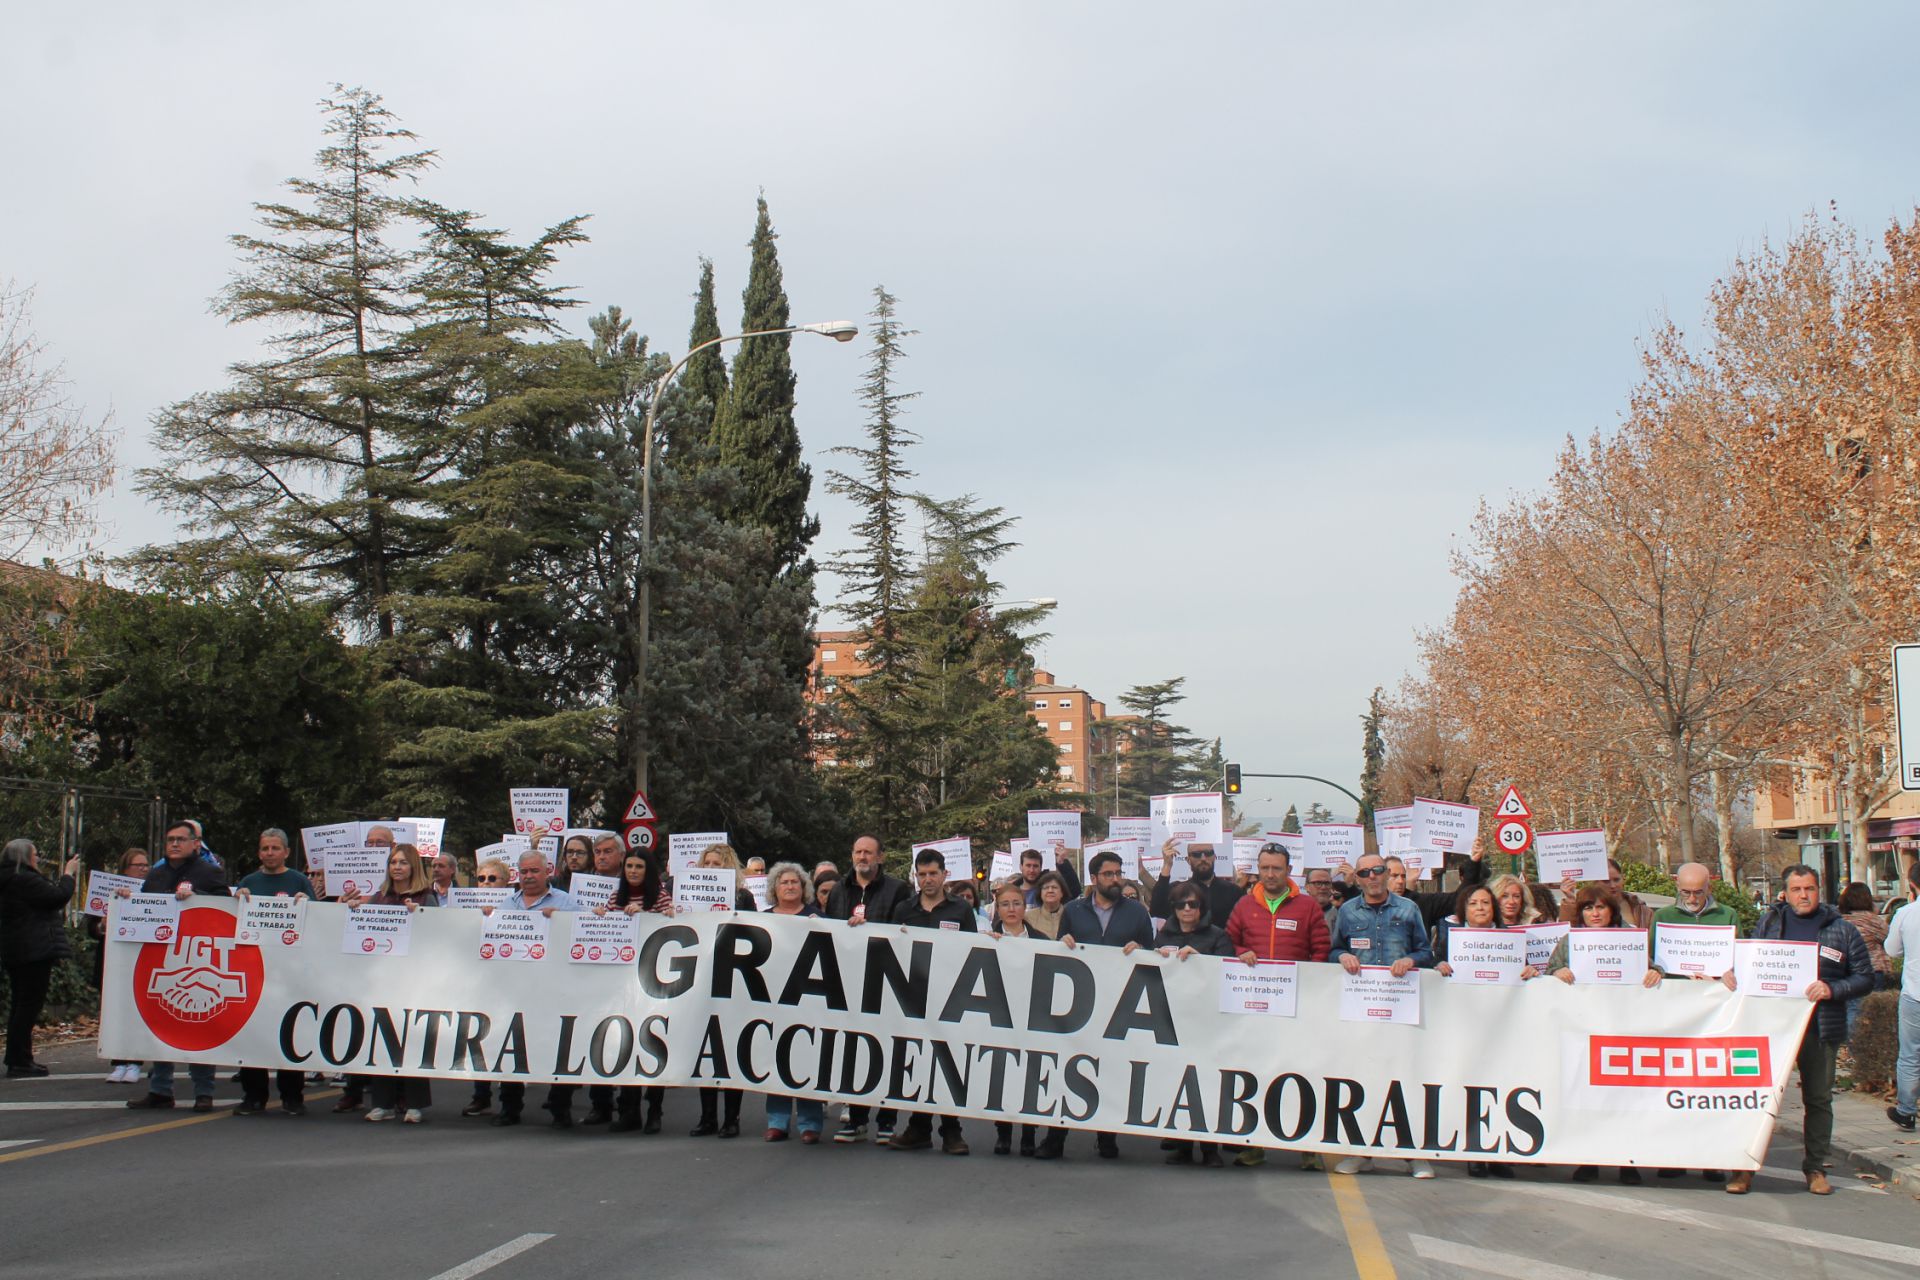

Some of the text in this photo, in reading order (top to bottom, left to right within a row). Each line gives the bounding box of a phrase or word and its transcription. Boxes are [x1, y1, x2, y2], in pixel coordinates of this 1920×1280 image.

[1184, 807, 1217, 815] muertes
[1442, 809, 1463, 818] salud
[1041, 819, 1079, 829] precariedad
[1182, 817, 1210, 827] trabajo
[314, 829, 346, 837] DENUNCIA
[1429, 829, 1458, 839] nómina
[1504, 831, 1523, 842] 30
[632, 833, 649, 845] 30
[1568, 848, 1604, 856] fundamental
[680, 884, 714, 892] MUERTES
[577, 890, 609, 899] MUERTES
[692, 895, 726, 903] TRABAJO
[121, 916, 174, 924] INCUMPLIMIENTO
[501, 913, 531, 921] CARCEL
[260, 921, 295, 929] TRABAJO
[484, 932, 545, 941] RESPONSABLES
[1660, 936, 1673, 944] No
[1694, 939, 1730, 947] muertes
[1462, 941, 1514, 951] Solidaridad
[1573, 943, 1645, 955] La precariedad
[166, 935, 237, 972] UGT
[1526, 951, 1550, 960] mata
[1680, 948, 1689, 956] el
[1690, 948, 1721, 959] trabajo
[1770, 948, 1796, 957] salud
[1453, 953, 1522, 963] con las familias
[1595, 956, 1622, 965] mata
[1765, 958, 1785, 969] está
[1225, 973, 1292, 983] No más muertes
[1757, 971, 1792, 982] nómina
[638, 922, 1178, 1046] GRANADA
[1244, 985, 1252, 993] el
[1254, 986, 1284, 996] trabajo
[1379, 996, 1401, 1004] trabajo
[1600, 1046, 1728, 1077] CCOO
[279, 1000, 1545, 1157] CONTRA LOS ACCIDENTES LABORALES
